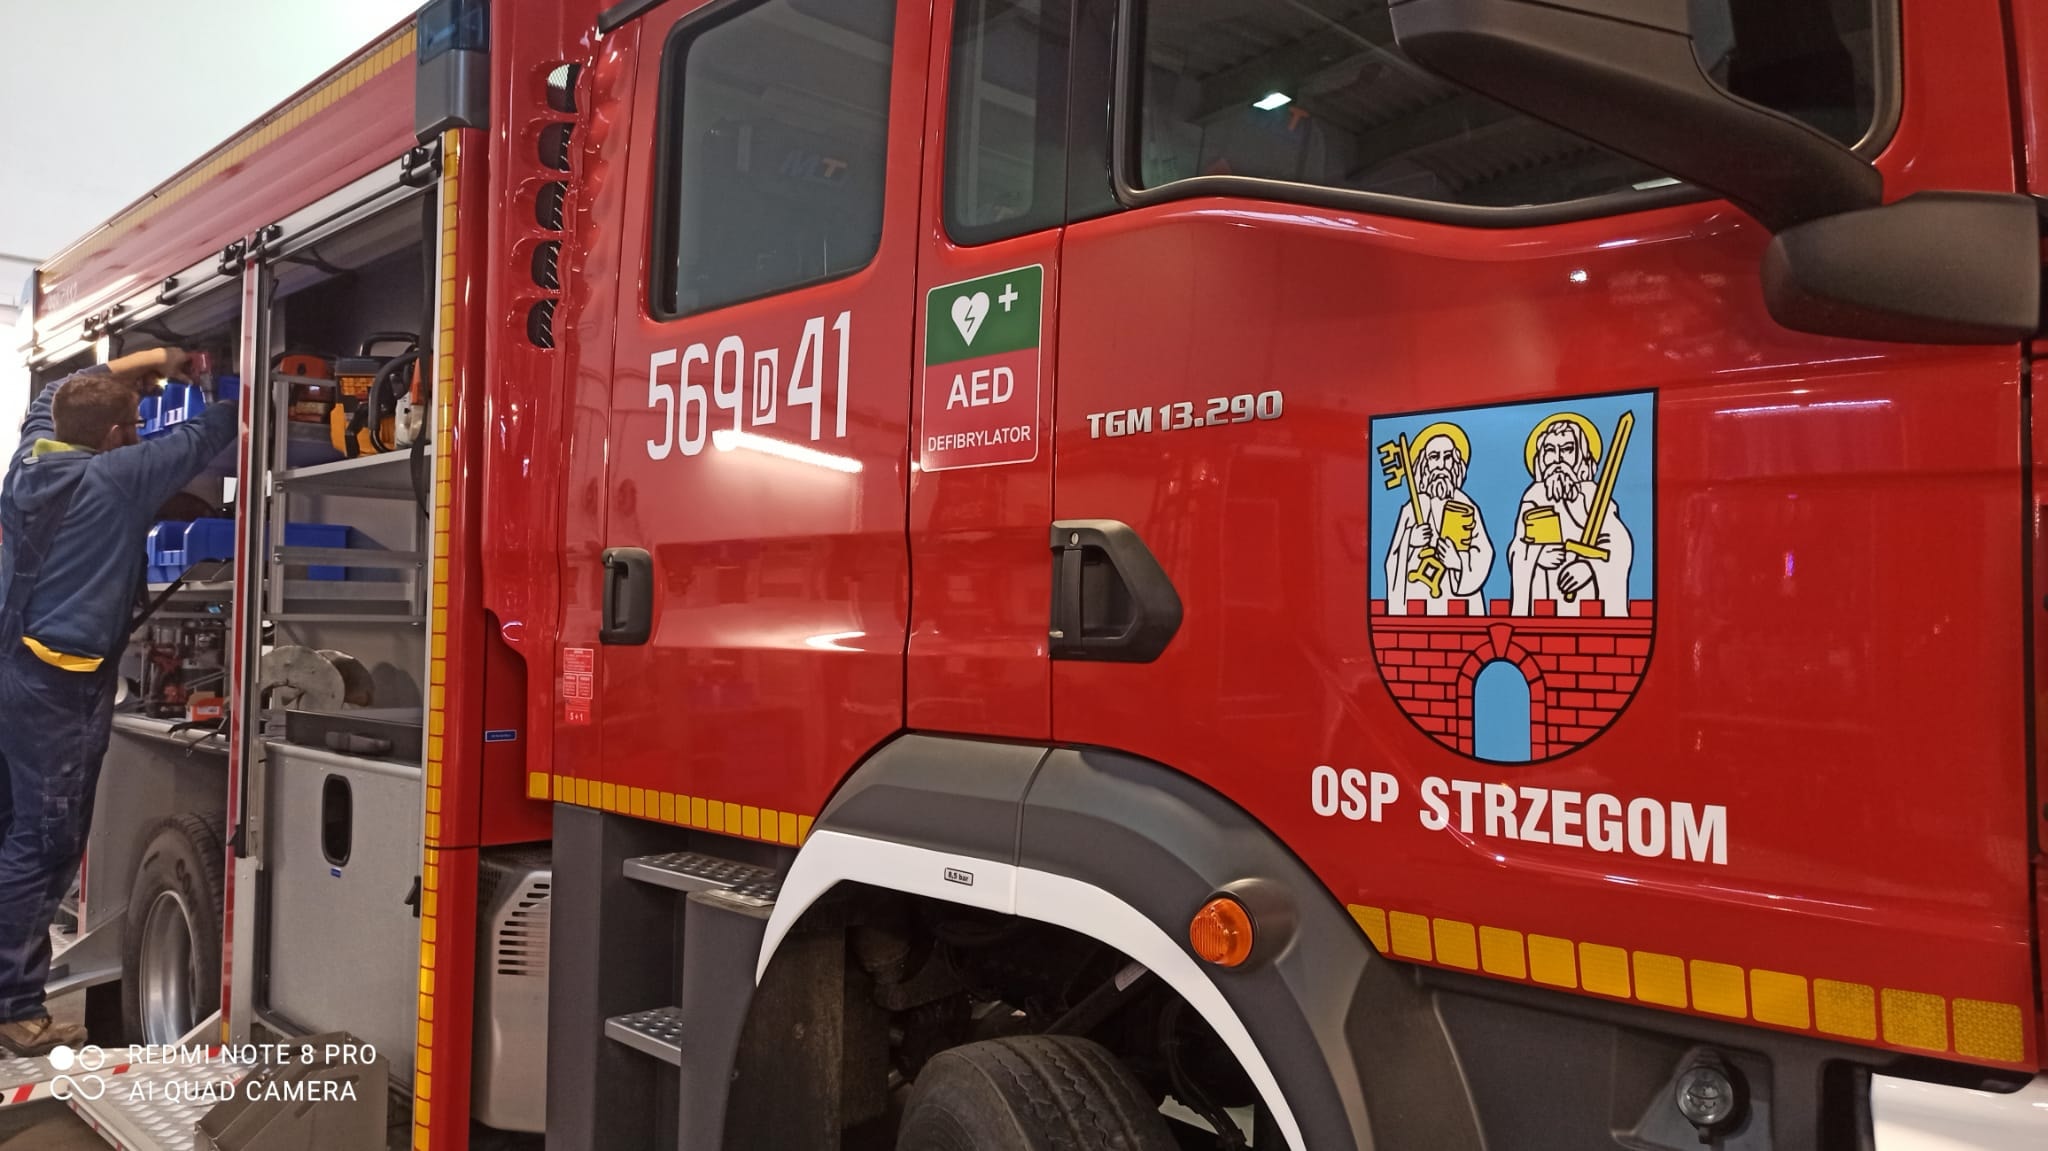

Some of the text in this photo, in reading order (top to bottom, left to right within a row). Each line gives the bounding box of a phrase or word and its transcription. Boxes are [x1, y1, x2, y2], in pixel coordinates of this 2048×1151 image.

[946, 366, 1014, 410] AED
[1087, 390, 1284, 439] TGM 13.290
[928, 425, 1031, 452] DEFIBRYLATOR
[1311, 765, 1729, 865] OSP STRZEGOM
